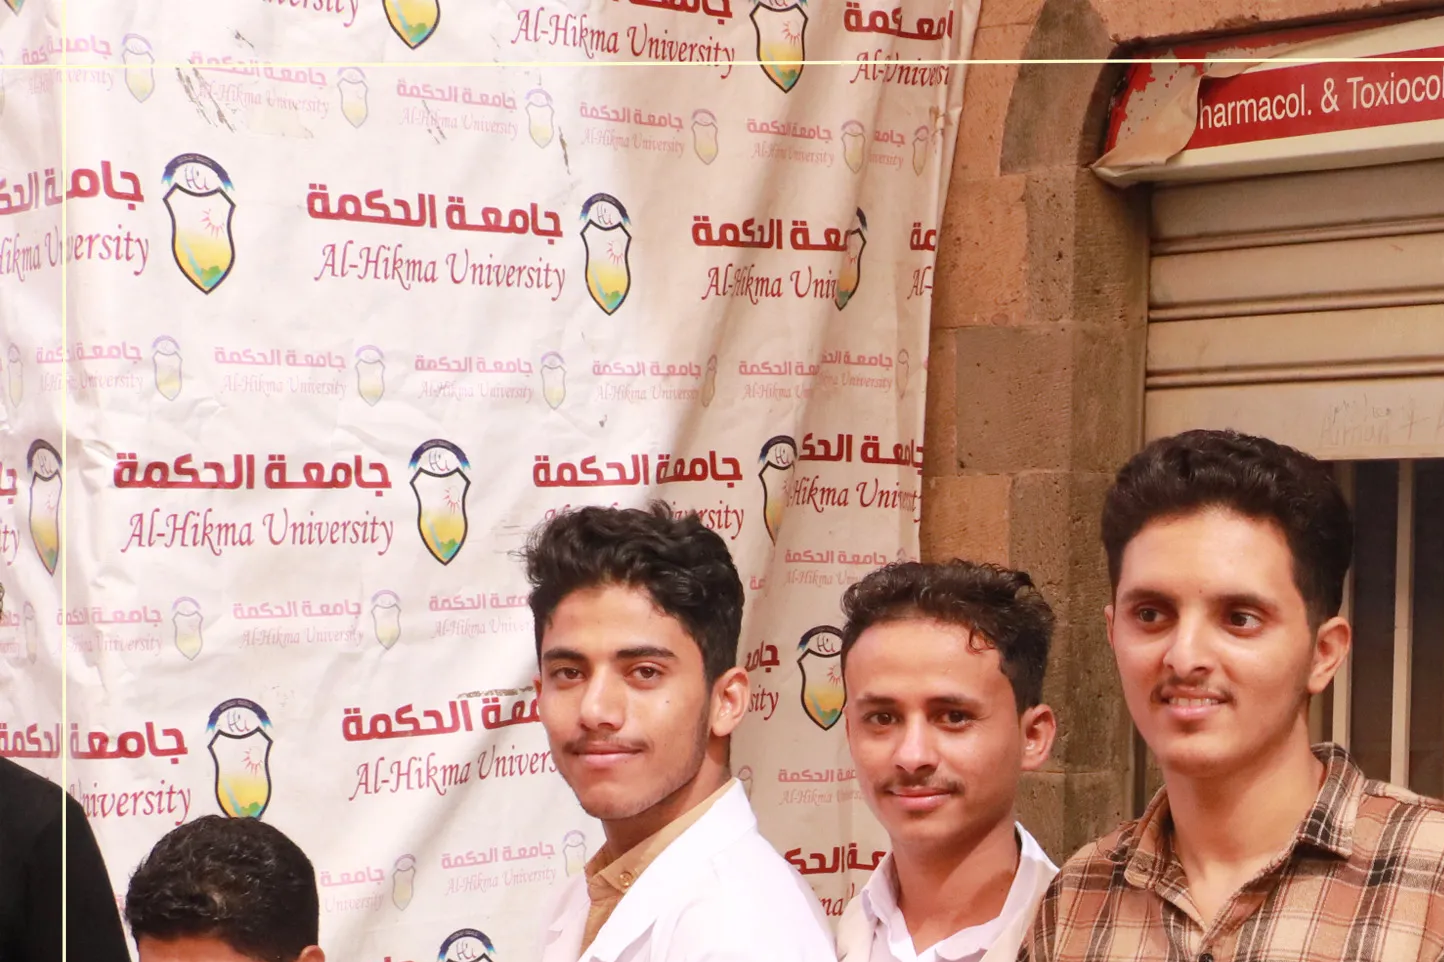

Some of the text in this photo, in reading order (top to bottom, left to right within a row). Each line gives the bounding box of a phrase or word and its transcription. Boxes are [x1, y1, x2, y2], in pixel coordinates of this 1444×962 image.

[510, 9, 619, 59] Al-Hikma
[628, 23, 736, 79] University
[397, 80, 517, 113] جامعة الحكمة
[1200, 88, 1312, 130] harmacol.
[1320, 79, 1339, 112] &
[579, 102, 683, 130] جامعة الحكمة
[874, 128, 906, 148] جامع
[307, 183, 563, 245] جامعة الحكمة
[314, 240, 565, 302] Al-Hikma University
[214, 346, 346, 372] جامعة الحكمة
[415, 355, 533, 377] جامعة الحكمة
[592, 359, 646, 376] الحكمة
[739, 360, 791, 376] الحكمة
[800, 433, 852, 463] الحك
[114, 452, 392, 497] جامعة الحكمة
[533, 451, 743, 488] جامعة الحكمة
[120, 507, 393, 556] Al-Hikma University
[233, 599, 362, 620] جامعة الحكمة
[429, 593, 530, 612] معة الحكمة
[342, 697, 540, 741] معة الحكمة
[70, 721, 188, 765] جامعة
[349, 745, 557, 801] Al-Hikma Univers
[441, 841, 555, 870] جامعة الحكمة
[784, 845, 845, 874] الحك
